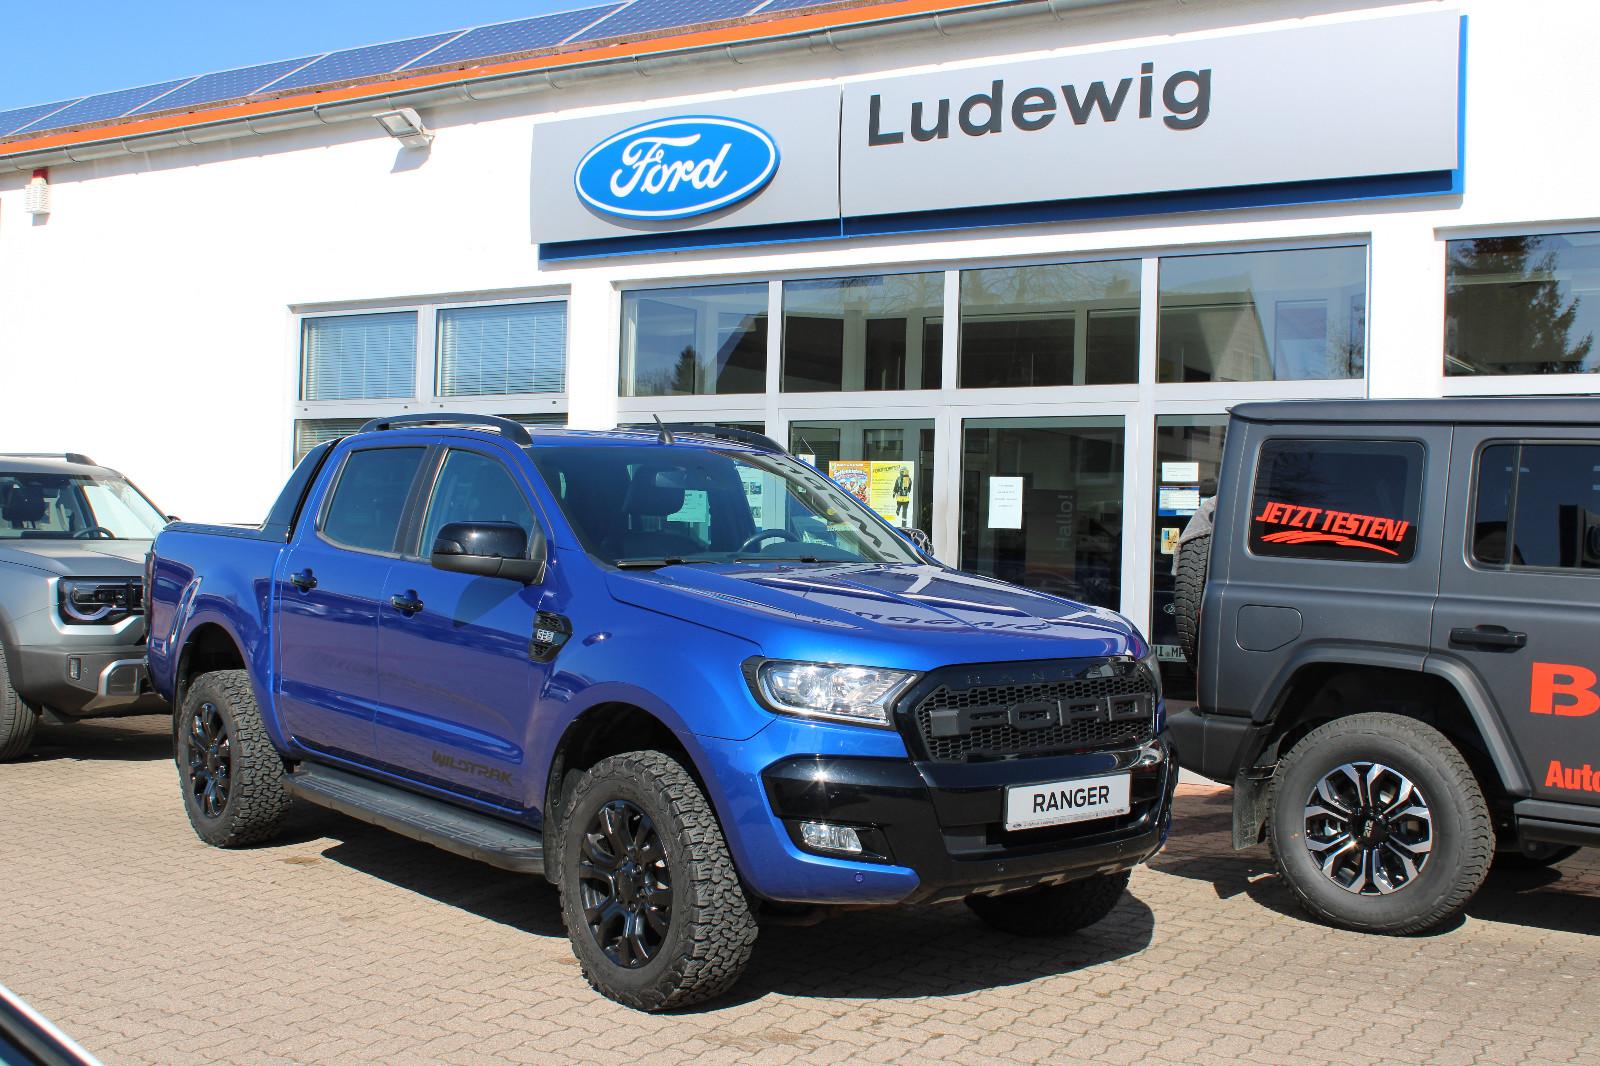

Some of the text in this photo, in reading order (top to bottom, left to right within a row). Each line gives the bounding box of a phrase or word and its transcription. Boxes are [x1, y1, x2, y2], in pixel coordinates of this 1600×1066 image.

[868, 62, 1212, 147] Ludewig
[610, 133, 733, 198] Ford
[1256, 501, 1409, 542] JETZT TESTEN!
[930, 694, 1151, 738] FORD
[1033, 785, 1110, 813] RANGER
